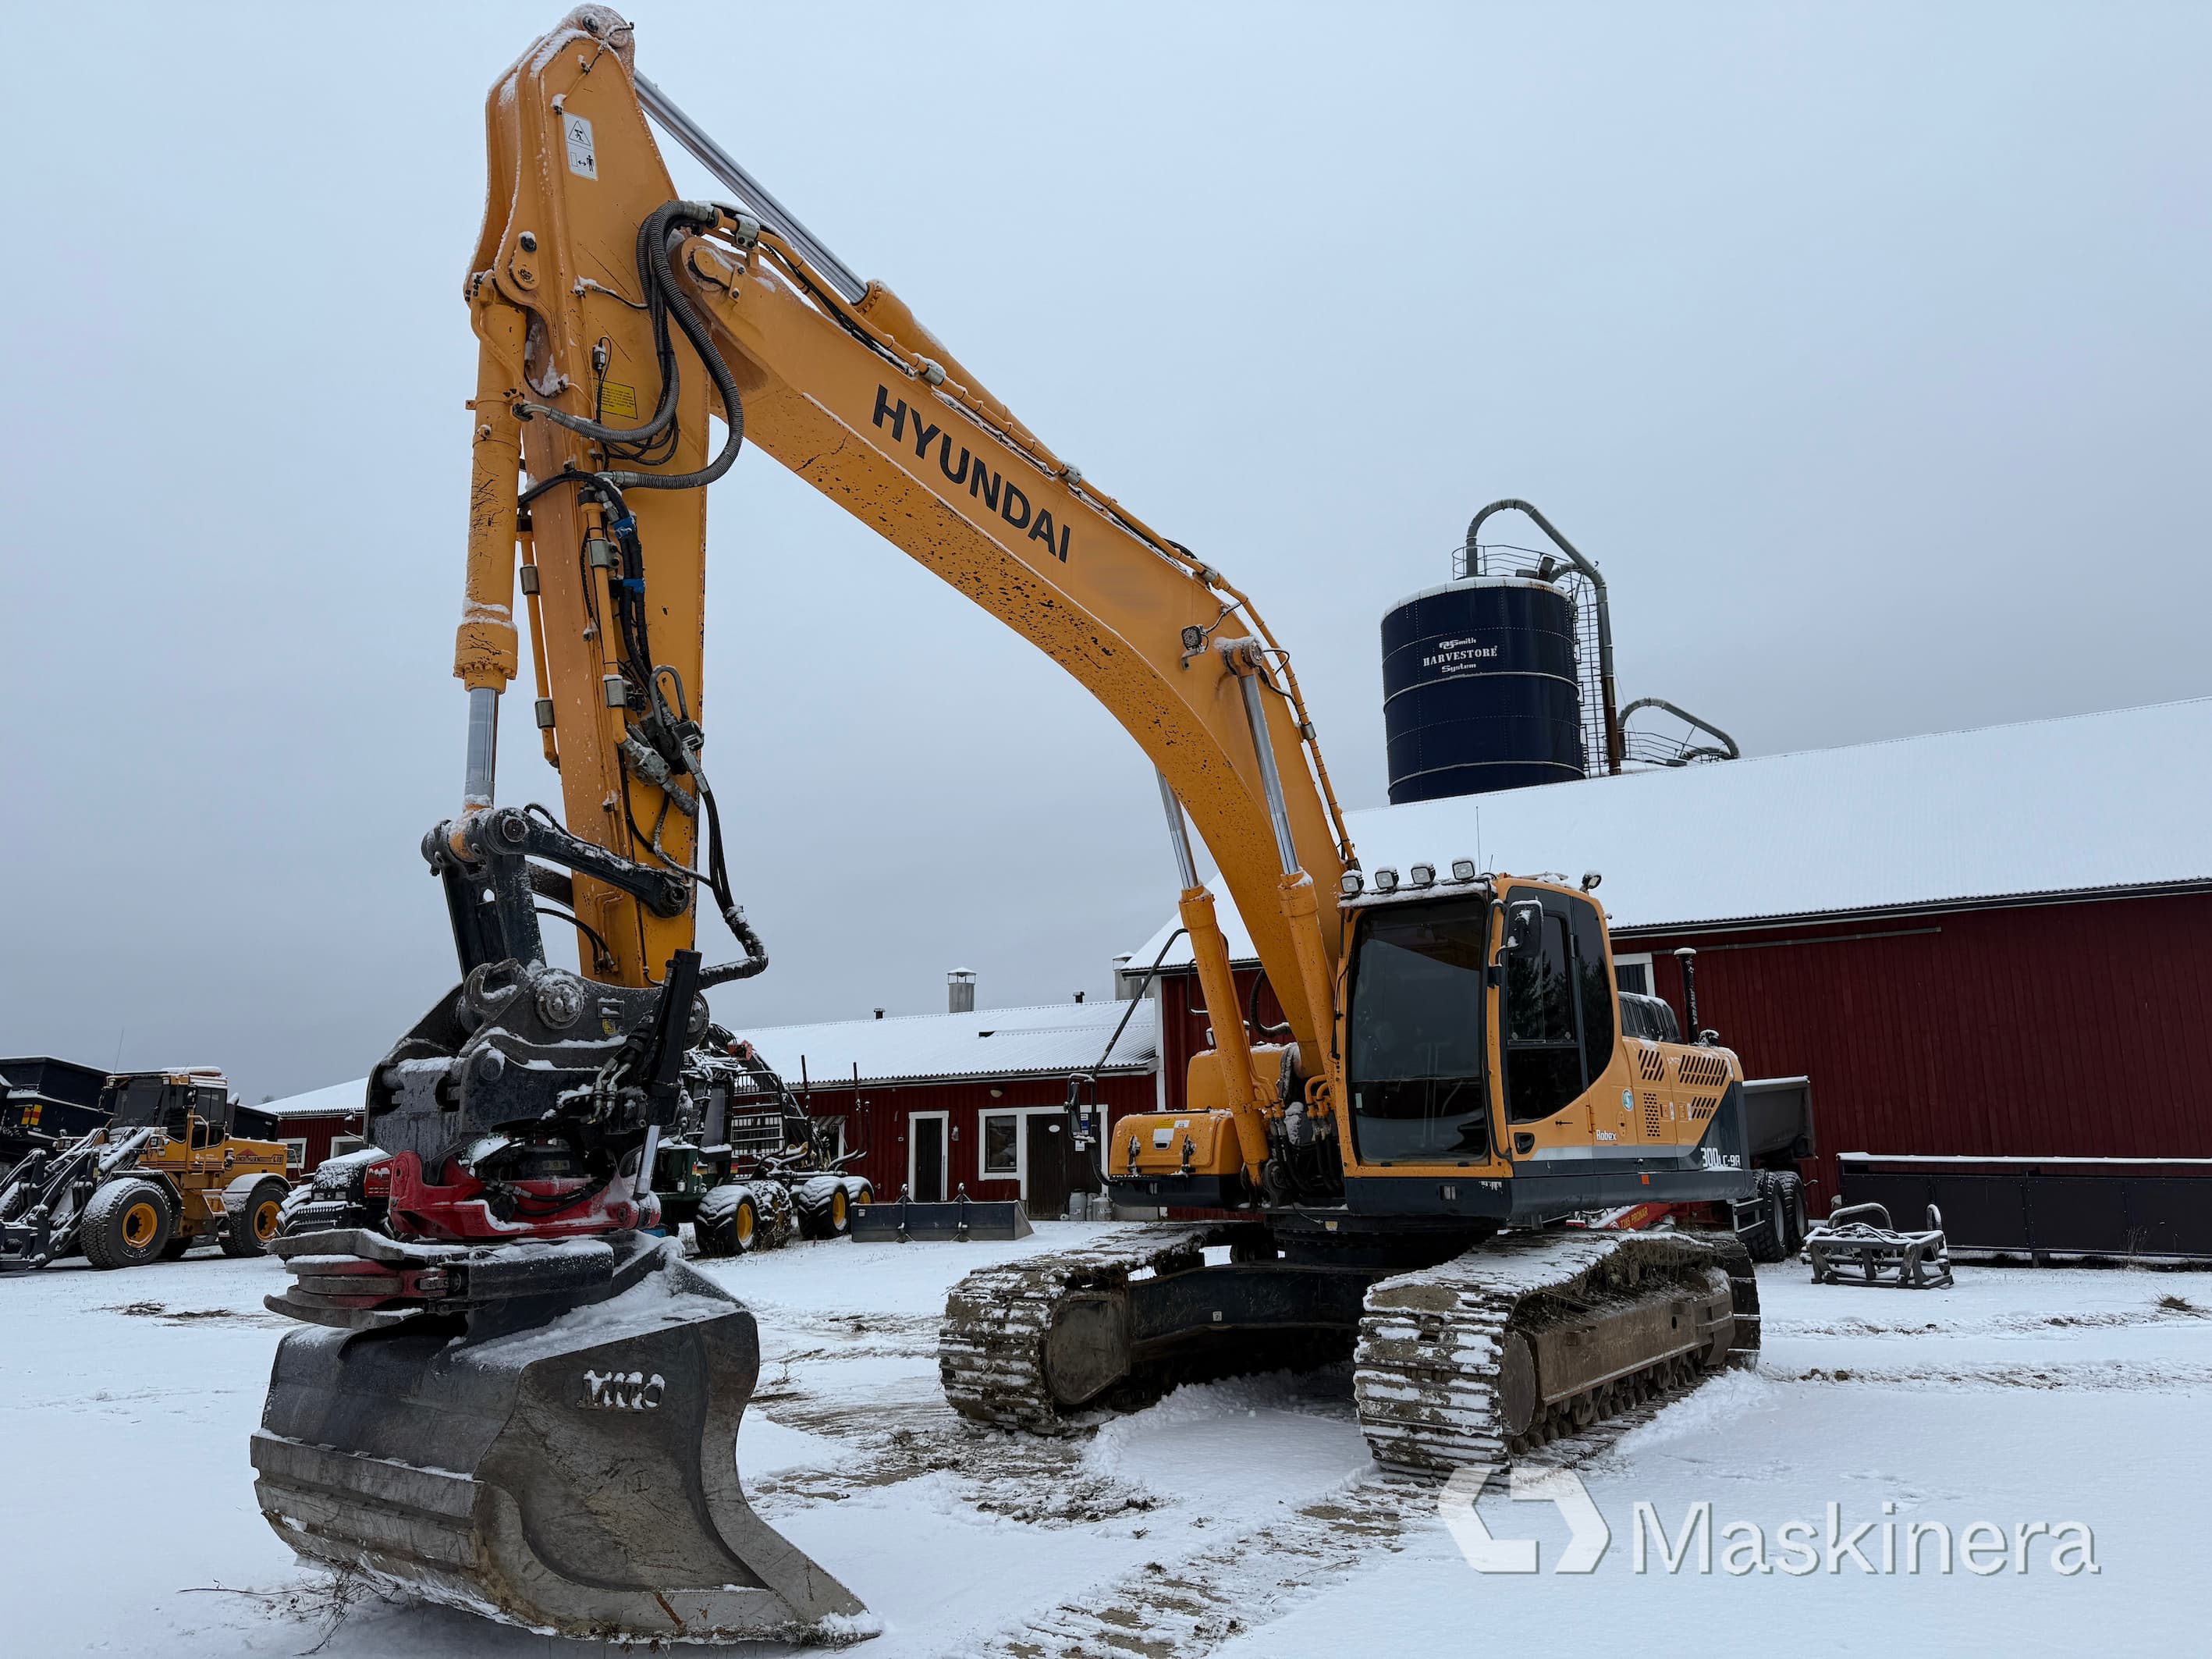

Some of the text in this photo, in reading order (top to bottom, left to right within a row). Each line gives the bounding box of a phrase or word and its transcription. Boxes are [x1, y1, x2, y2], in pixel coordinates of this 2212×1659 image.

[872, 383, 1070, 564] HYUNDAI
[1423, 648, 1497, 666] HARVESTORE
[1596, 1129, 1617, 1141] Robex
